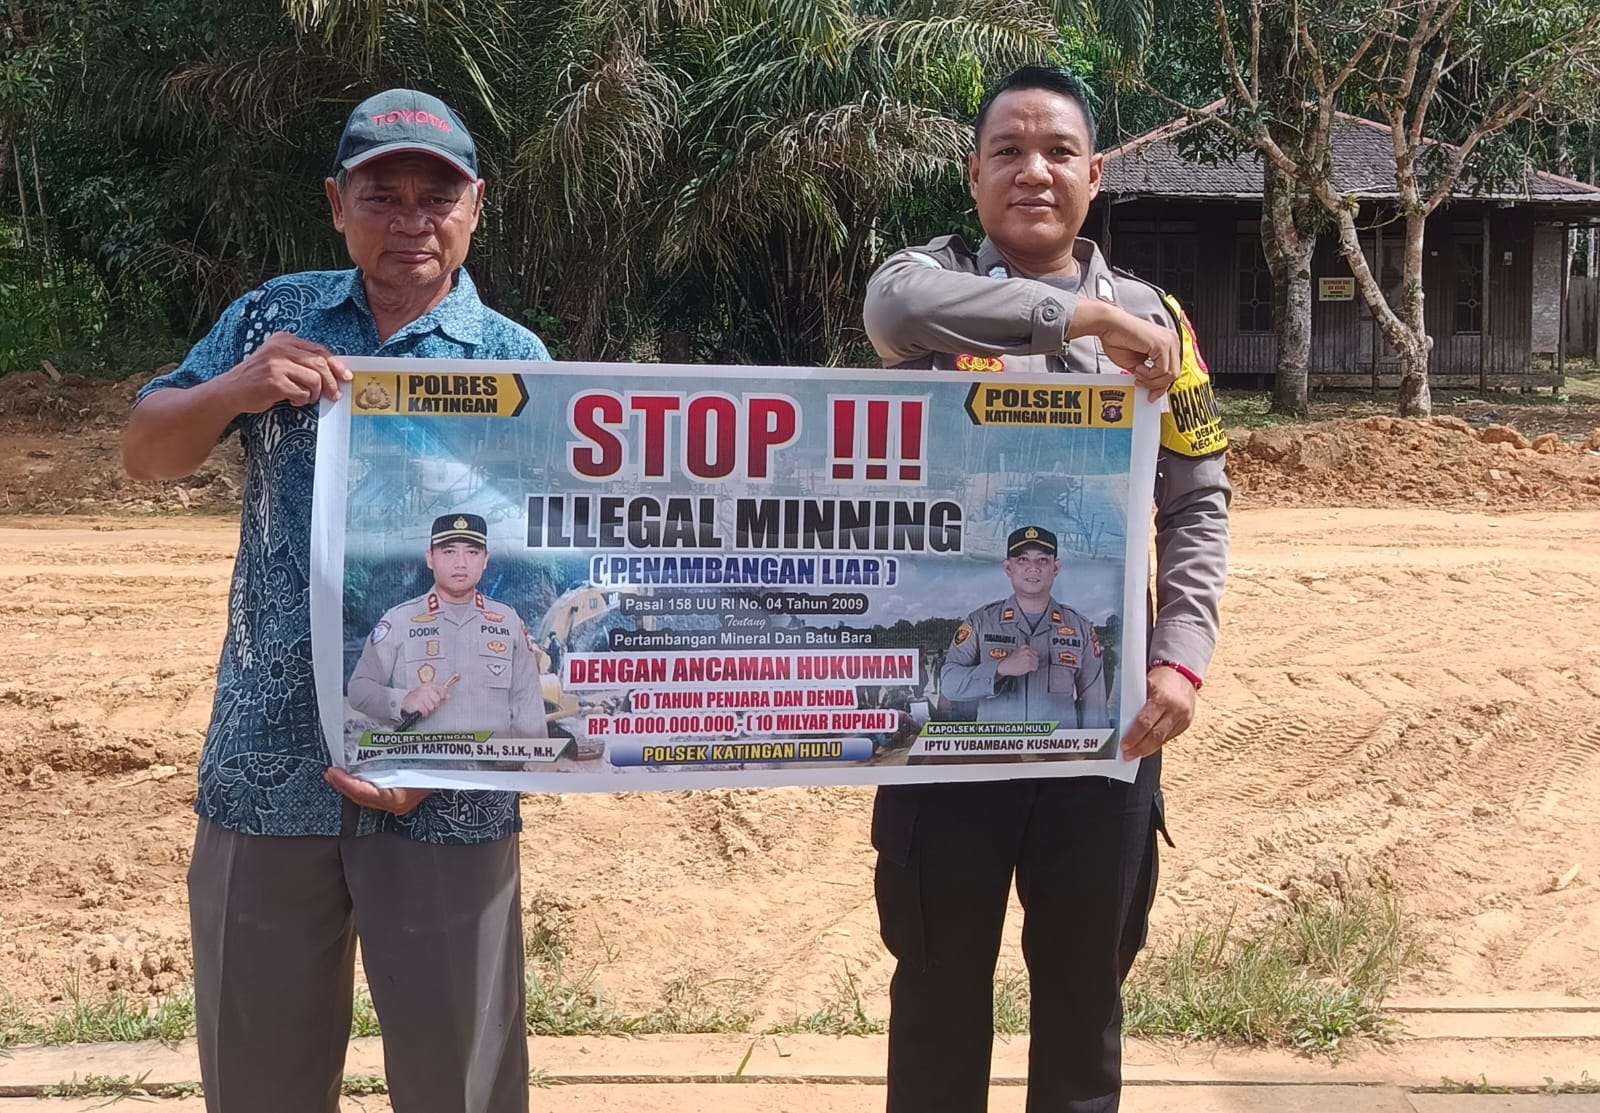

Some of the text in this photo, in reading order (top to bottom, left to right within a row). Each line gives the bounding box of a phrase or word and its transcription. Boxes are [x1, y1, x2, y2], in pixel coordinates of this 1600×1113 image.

[372, 110, 452, 132] TOYOTA
[408, 374, 498, 396] POLRES
[408, 397, 498, 413] KATINGAN
[985, 388, 1082, 409] POLSEK
[985, 410, 1082, 424] KATINGAN HULU
[571, 393, 924, 481] STOP !!!
[526, 495, 963, 552] ILLEGAL MINNING
[625, 598, 864, 610] Pasal 158 UU RI No. 04 Tahun 2009
[724, 614, 766, 630] Tentang
[409, 627, 440, 639] DODIK
[480, 624, 510, 637] POLRI
[614, 631, 872, 648] Pertambangan Mineral Dan Batu Bara
[570, 655, 913, 684] DENGAN ANCAMAN HUKUMAN
[633, 689, 855, 710] 10 TAHUN PENJARA DAN DENDA
[588, 718, 610, 735] RP.
[776, 714, 828, 731] MILYAR
[928, 723, 1050, 735] KAPOLSEK KATINGAN HULU
[372, 733, 474, 744] KAPOLRES KATINGAN
[924, 738, 1098, 752] IPTU YUBAMBANG KUSNADY, SH
[422, 743, 475, 757] HARTONO,
[476, 744, 499, 757] S.H.,
[534, 746, 556, 757] M.H.
[643, 741, 842, 763] POLSEK KATINGAN HULU
